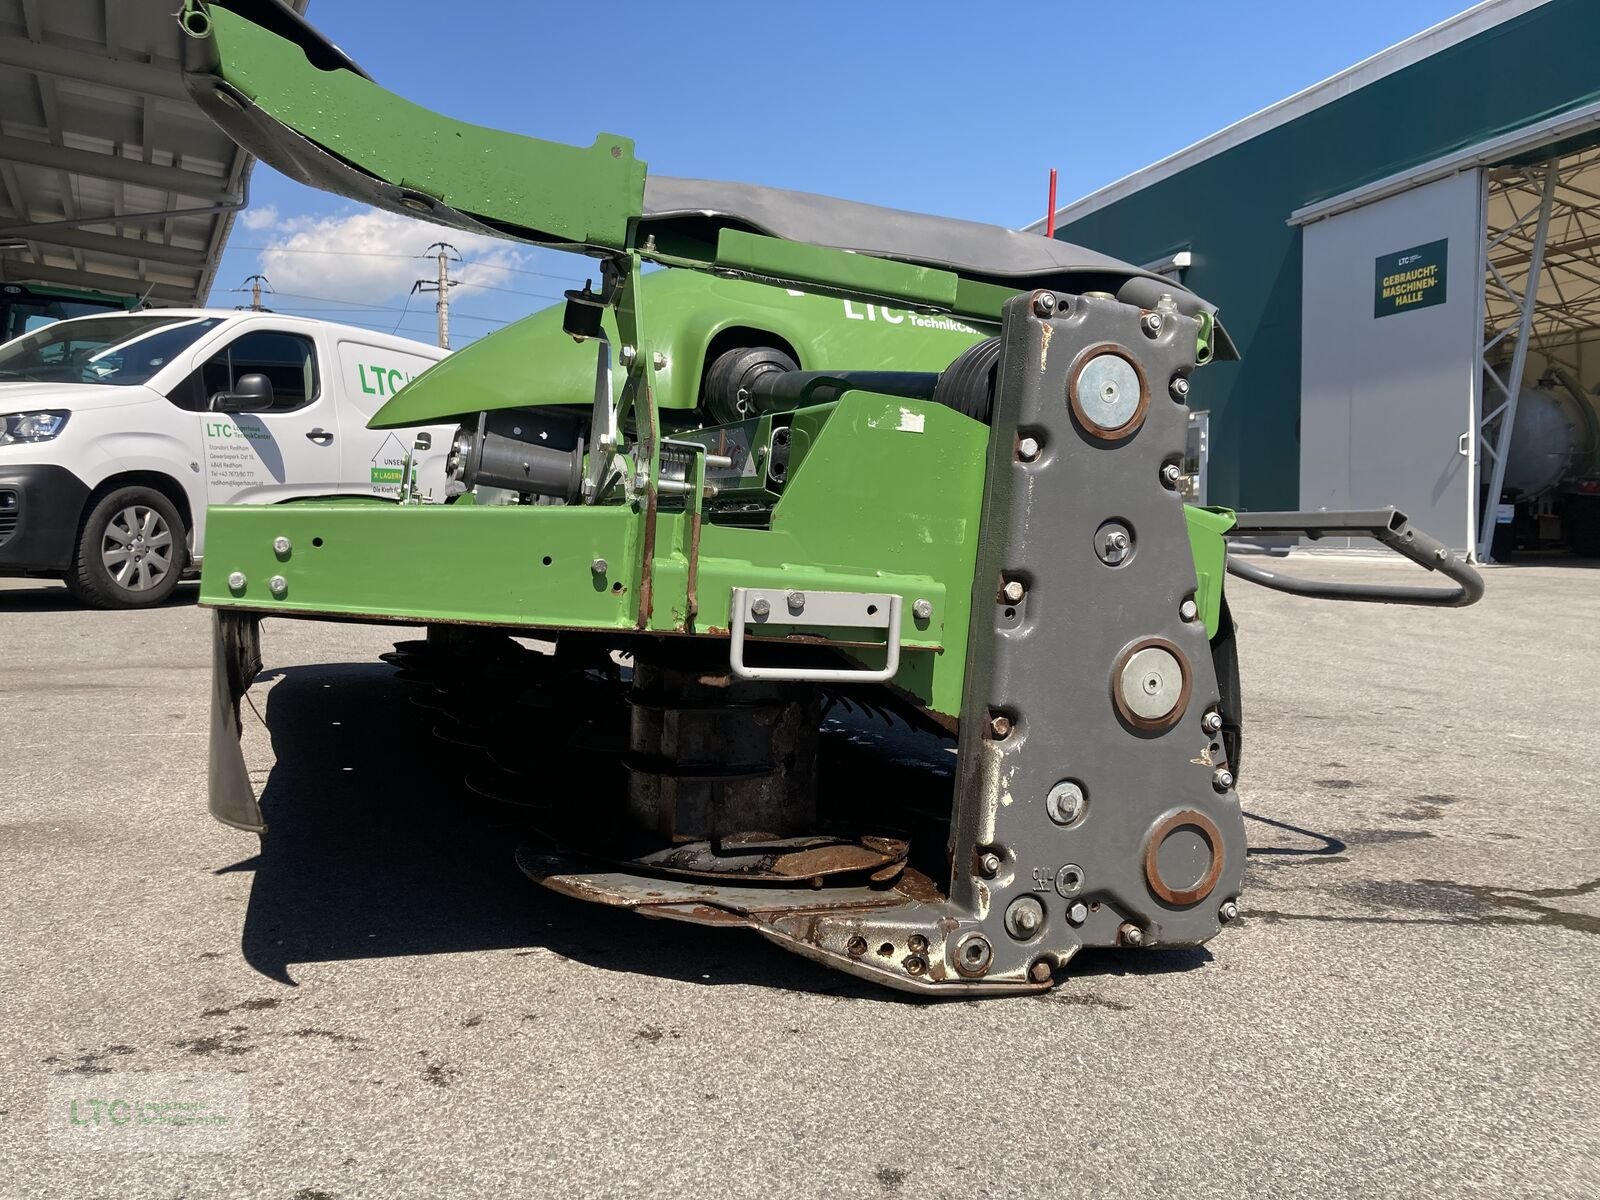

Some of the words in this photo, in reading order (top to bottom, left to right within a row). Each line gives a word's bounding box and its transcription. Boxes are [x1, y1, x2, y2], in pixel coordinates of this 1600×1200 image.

[1383, 264, 1438, 287] GEBRAUCHT-
[1382, 276, 1438, 299] MASCHINEN-
[1395, 291, 1423, 306] HALLE
[358, 363, 403, 396] LTC
[206, 423, 232, 438] LTC
[1032, 866, 1054, 881] OIL
